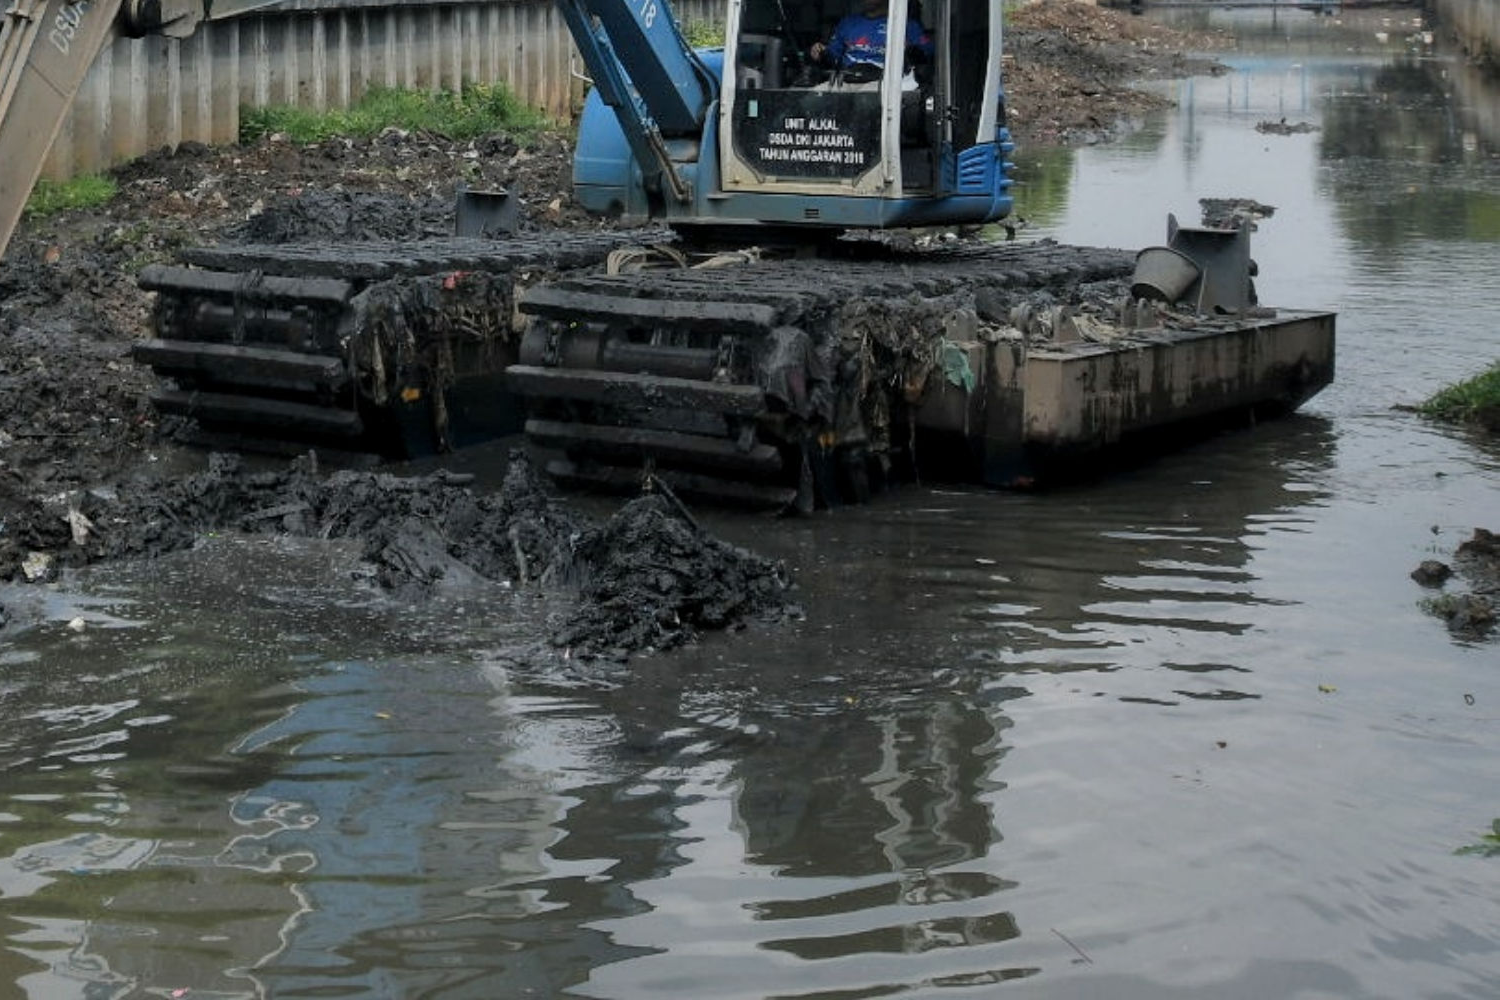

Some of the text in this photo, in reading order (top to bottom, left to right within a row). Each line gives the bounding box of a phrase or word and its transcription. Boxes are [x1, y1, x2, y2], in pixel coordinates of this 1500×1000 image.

[784, 117, 839, 131] UNIT ALKAL
[812, 134, 854, 148] JAKARTA
[759, 147, 790, 161] TAHUN
[790, 149, 842, 163] ANGGARAN
